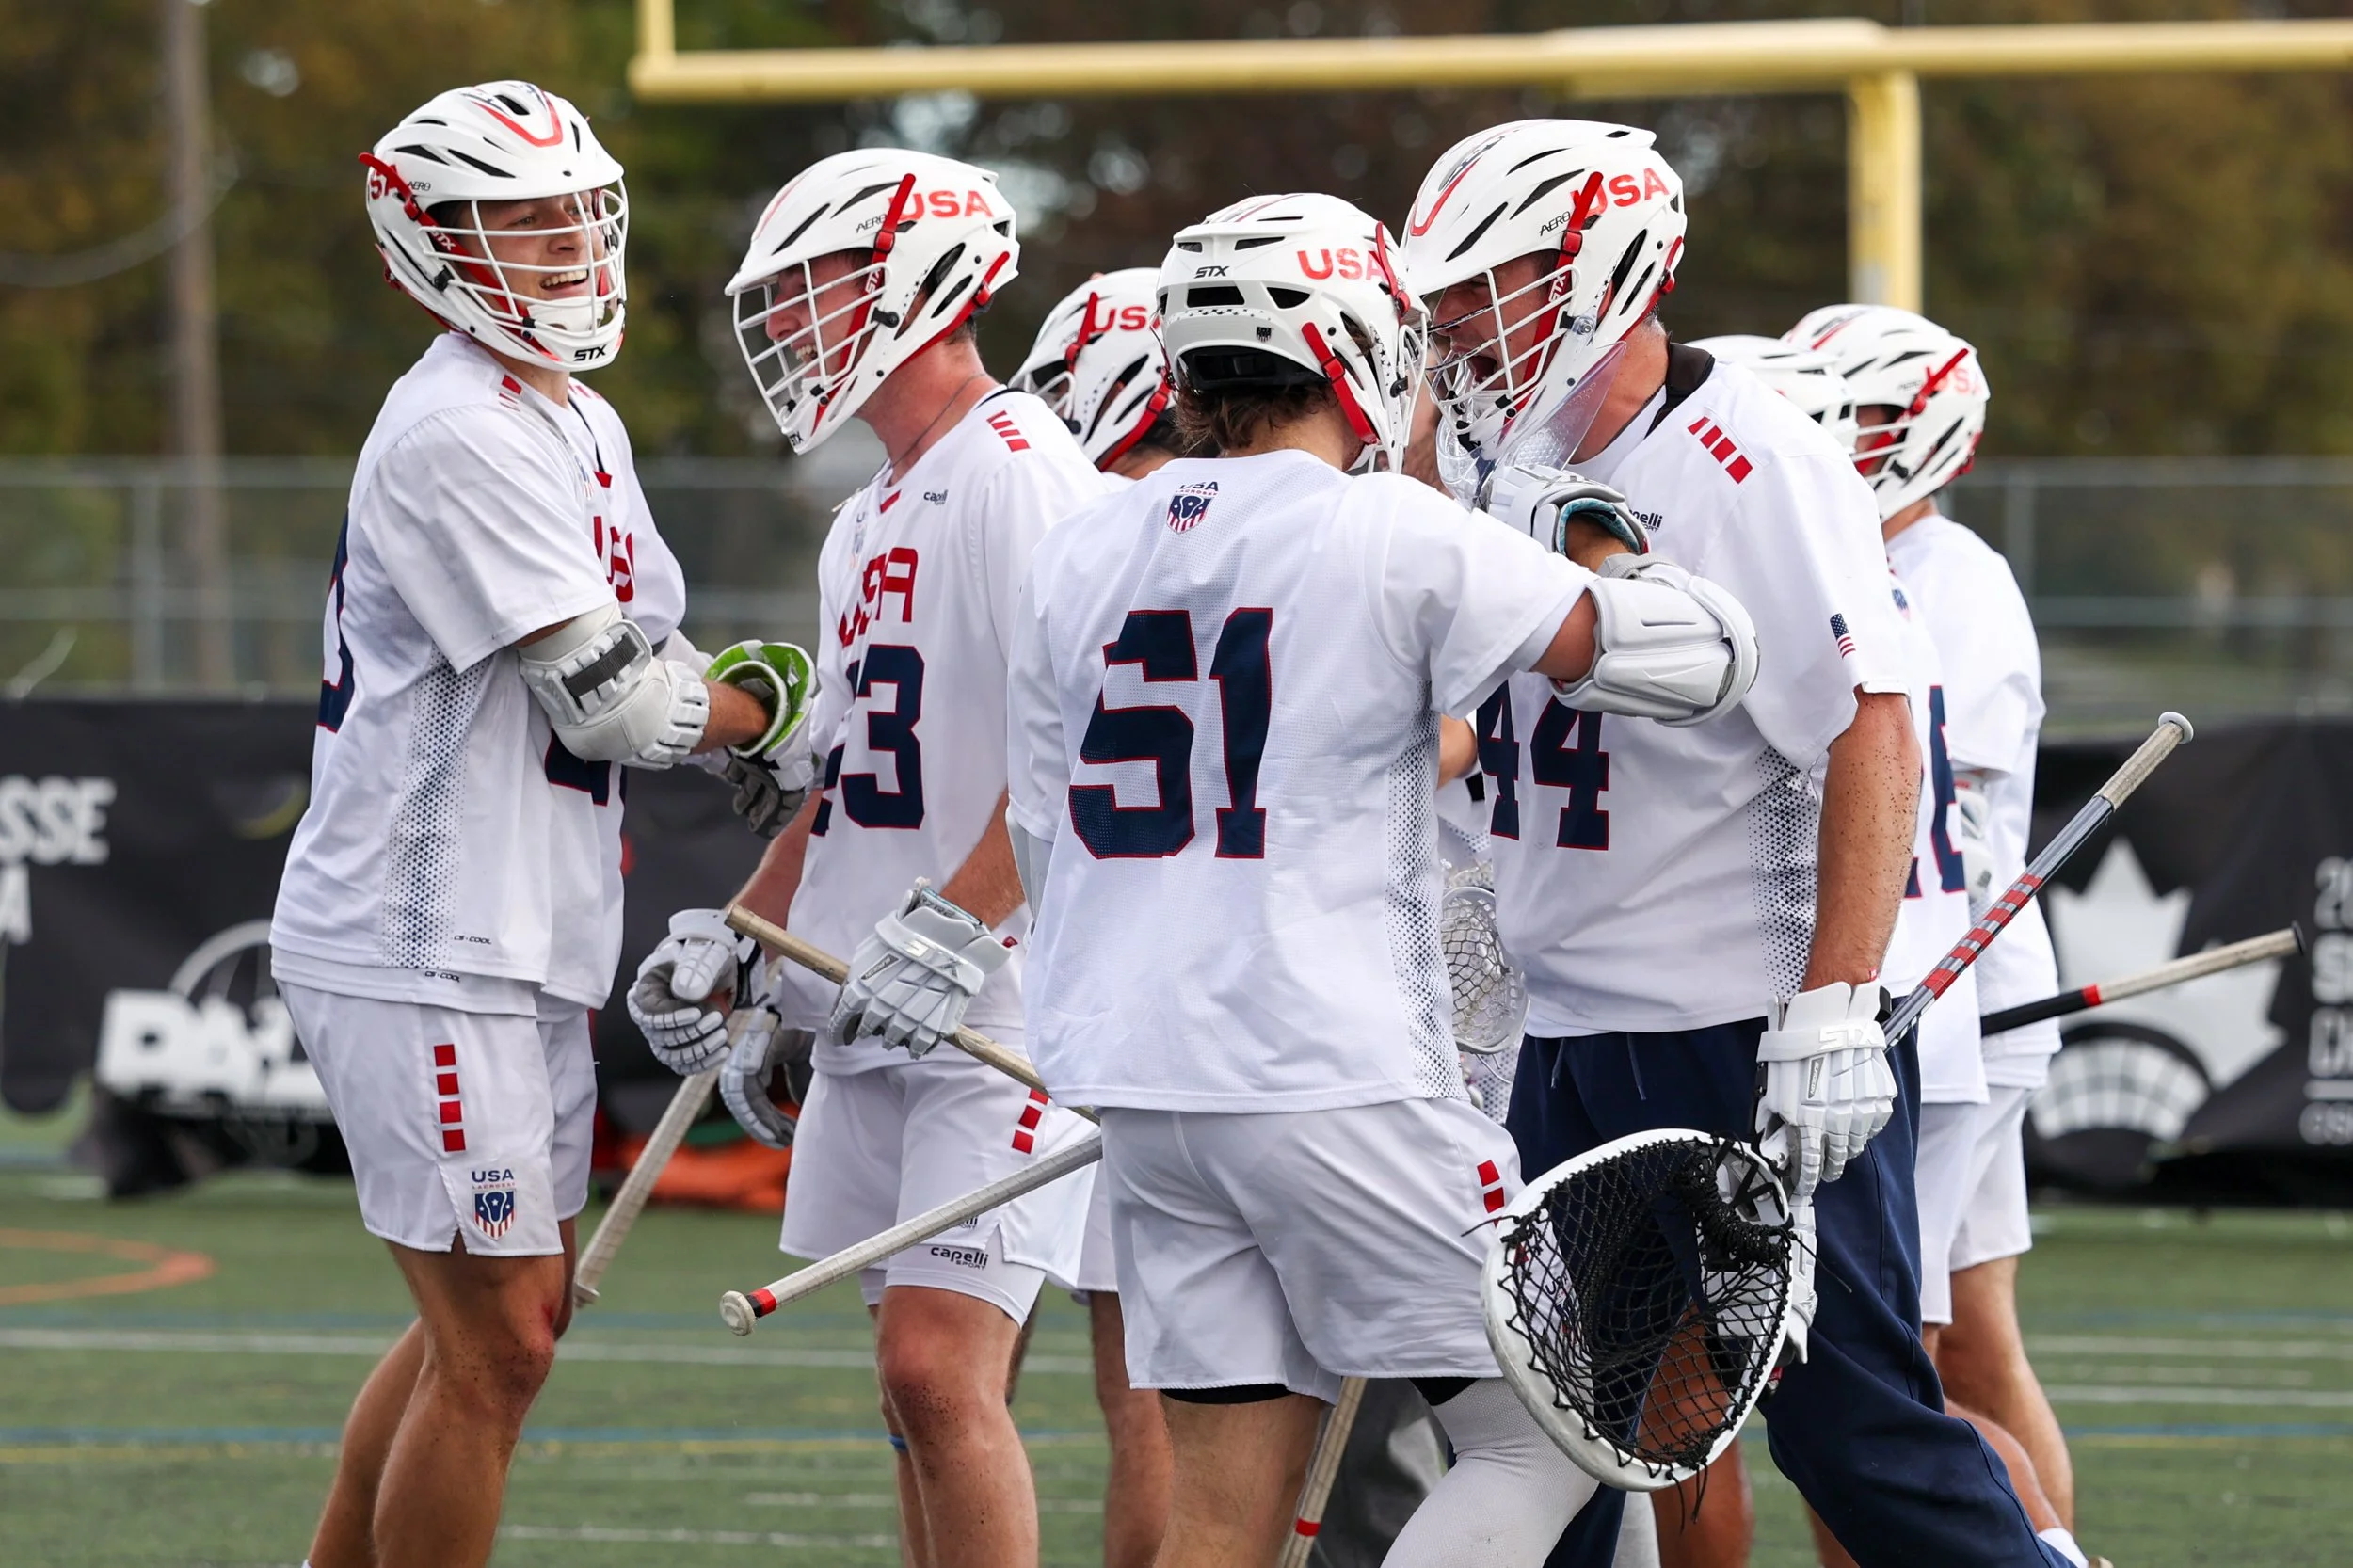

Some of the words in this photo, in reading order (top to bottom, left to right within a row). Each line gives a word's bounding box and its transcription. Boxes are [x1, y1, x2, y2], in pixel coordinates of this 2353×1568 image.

[408, 181, 431, 191] AERO
[1570, 168, 1670, 218] USA
[888, 190, 994, 221] USA
[1540, 211, 1571, 236] AERO
[1193, 265, 1229, 279] STX
[1091, 306, 1160, 333] US
[574, 344, 607, 361] STX
[1068, 607, 1273, 859] 51
[1476, 680, 1609, 852] 44
[1818, 1022, 1879, 1051] STX
[472, 1168, 515, 1183] USA
[930, 1246, 989, 1267] capelli
[955, 1259, 986, 1271] SPORT
